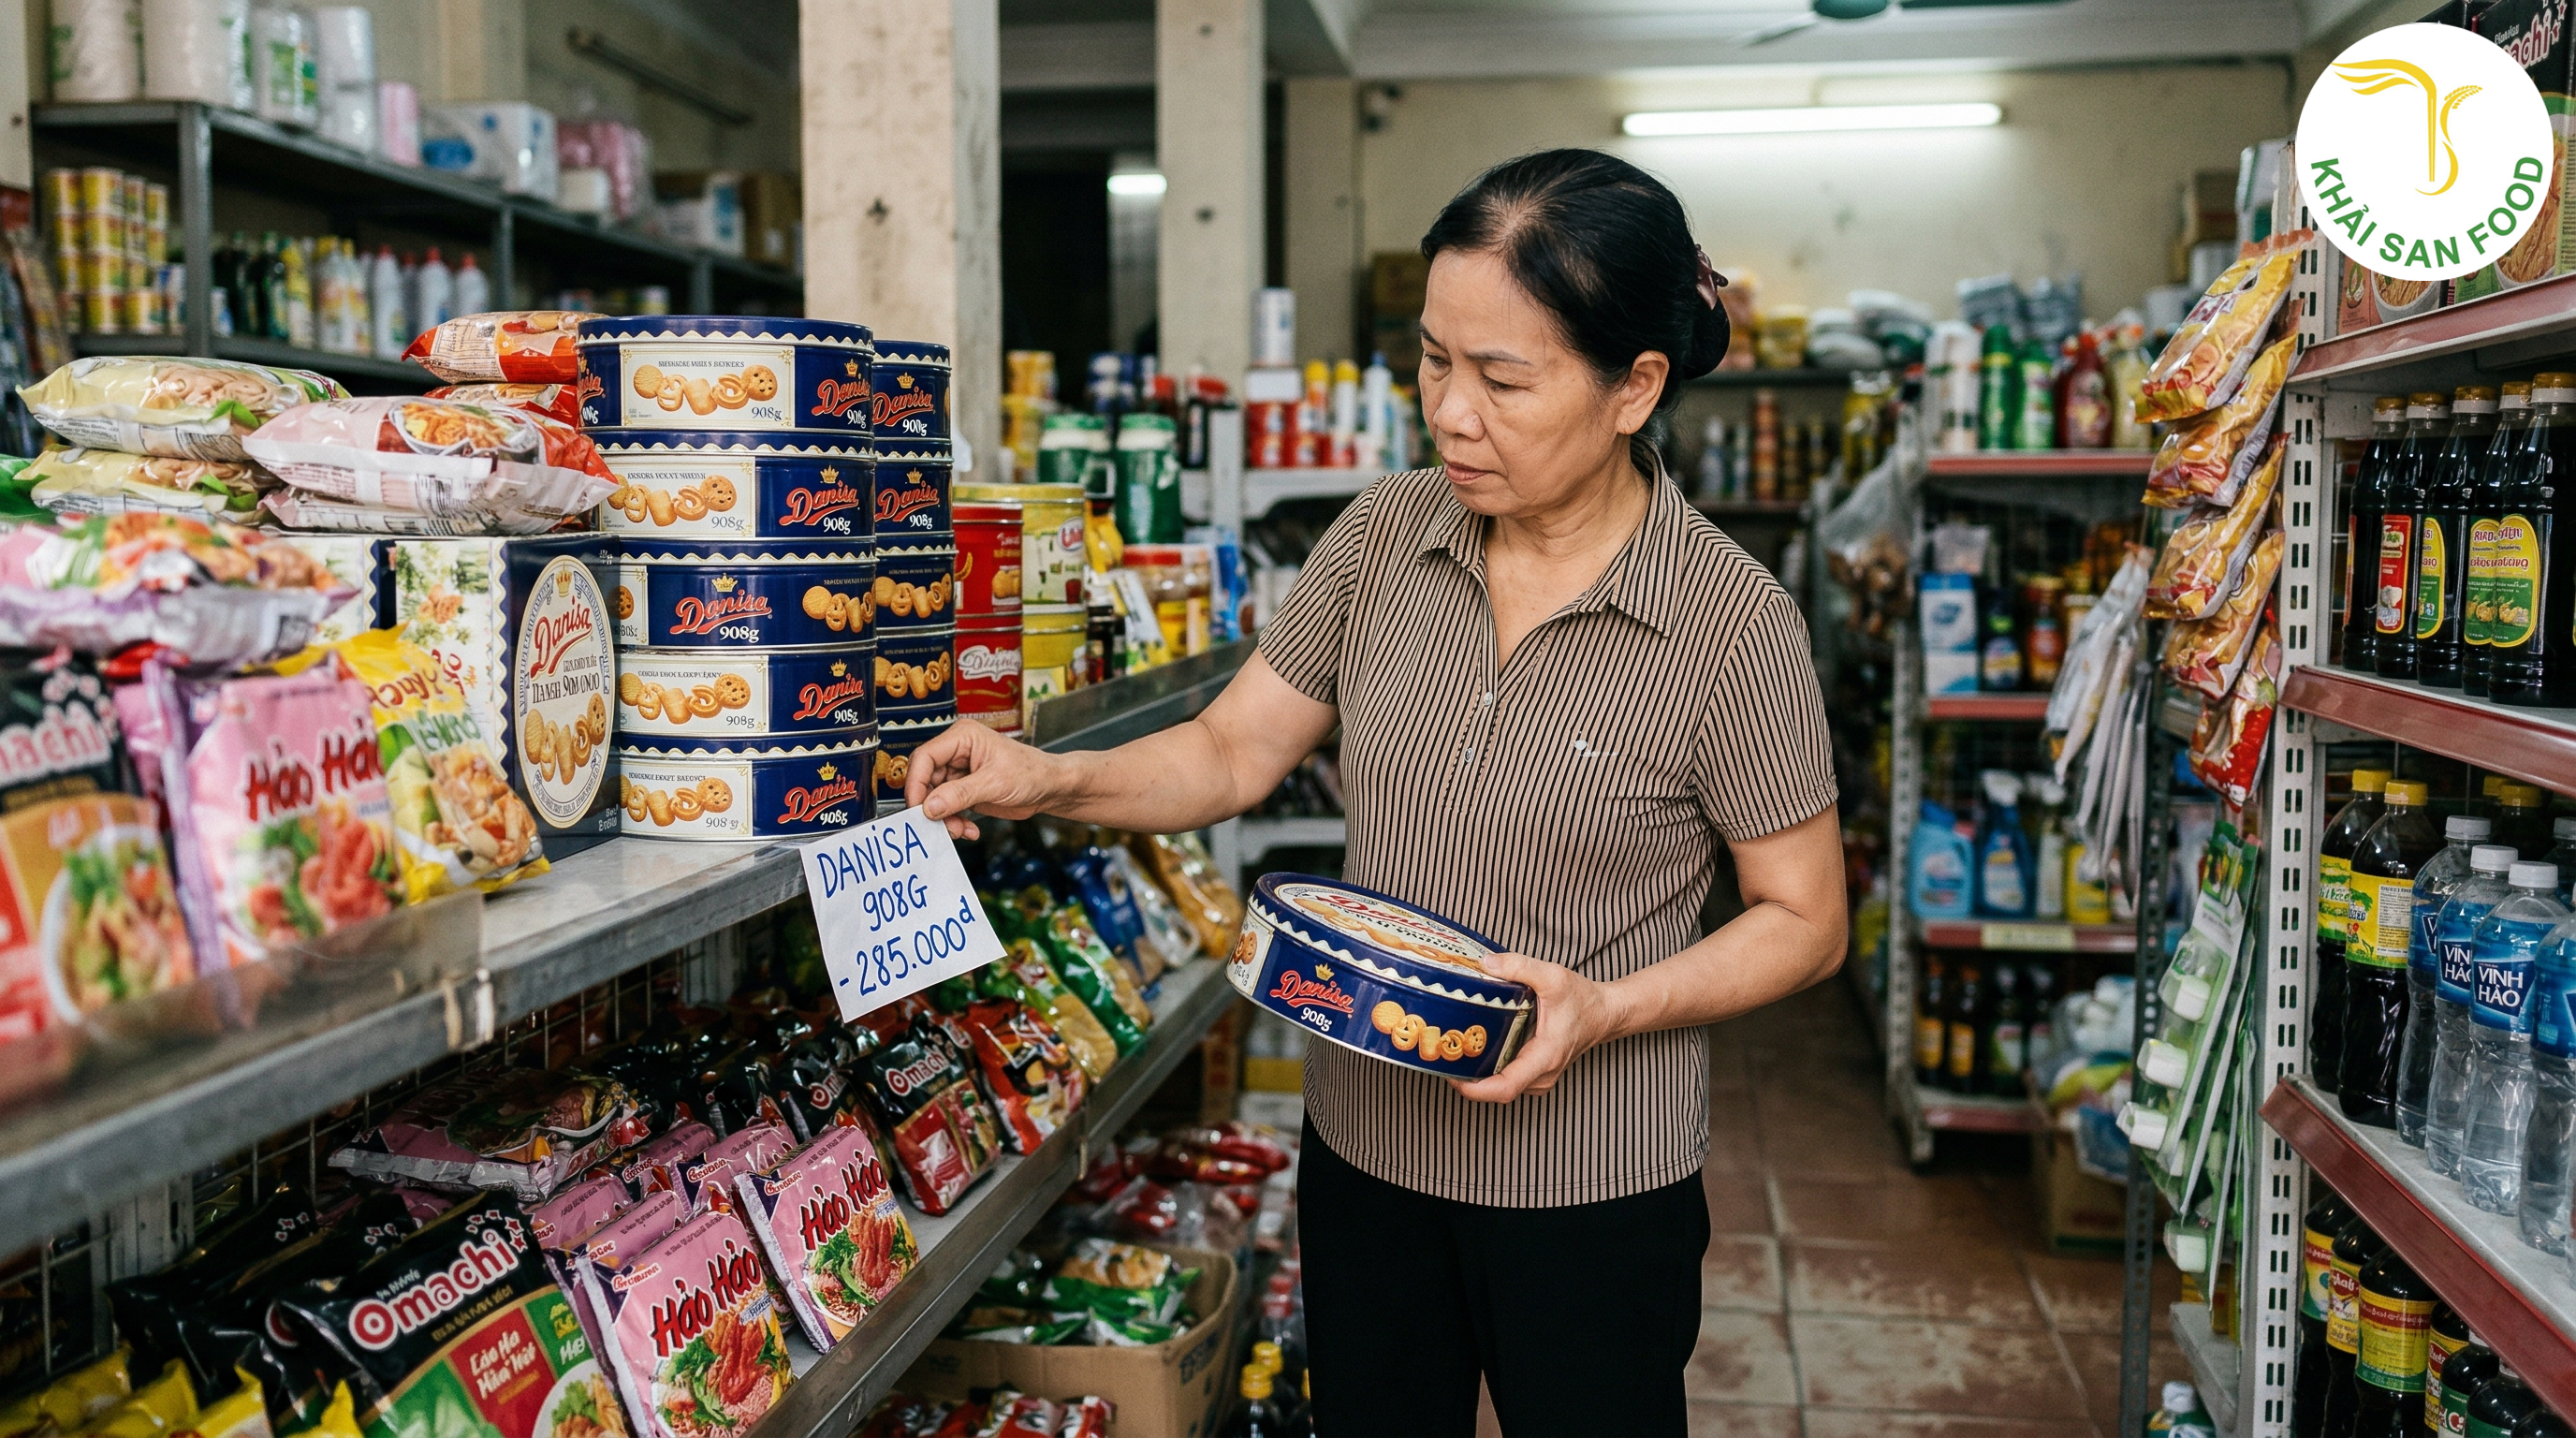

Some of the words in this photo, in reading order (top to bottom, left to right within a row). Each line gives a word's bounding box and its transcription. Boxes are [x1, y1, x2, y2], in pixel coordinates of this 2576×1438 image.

[2503, 8, 2552, 69] achi
[752, 406, 783, 421] 908g
[711, 516, 746, 531] 908g
[778, 479, 859, 526] Danisa
[874, 479, 940, 522] Danisa
[823, 516, 851, 536] 908g
[669, 589, 772, 635] Danisa
[719, 625, 760, 643] 908g
[530, 594, 593, 682] Danisa
[793, 673, 864, 721] Danisa
[0, 701, 111, 785] achi
[725, 715, 755, 729] 908g
[319, 715, 386, 796] Hả
[777, 774, 858, 825] Danisa
[862, 873, 929, 932] 908G
[2444, 944, 2471, 965] VIN
[2479, 965, 2524, 989] VINH
[1269, 970, 1355, 1014] Danisa
[886, 1045, 950, 1096] Omach
[799, 1183, 852, 1252] Hảo
[842, 1149, 888, 1212] Hảo
[349, 1228, 519, 1351] Omachi
[651, 1276, 715, 1358] Hảo
[707, 1240, 762, 1312] Hảo
